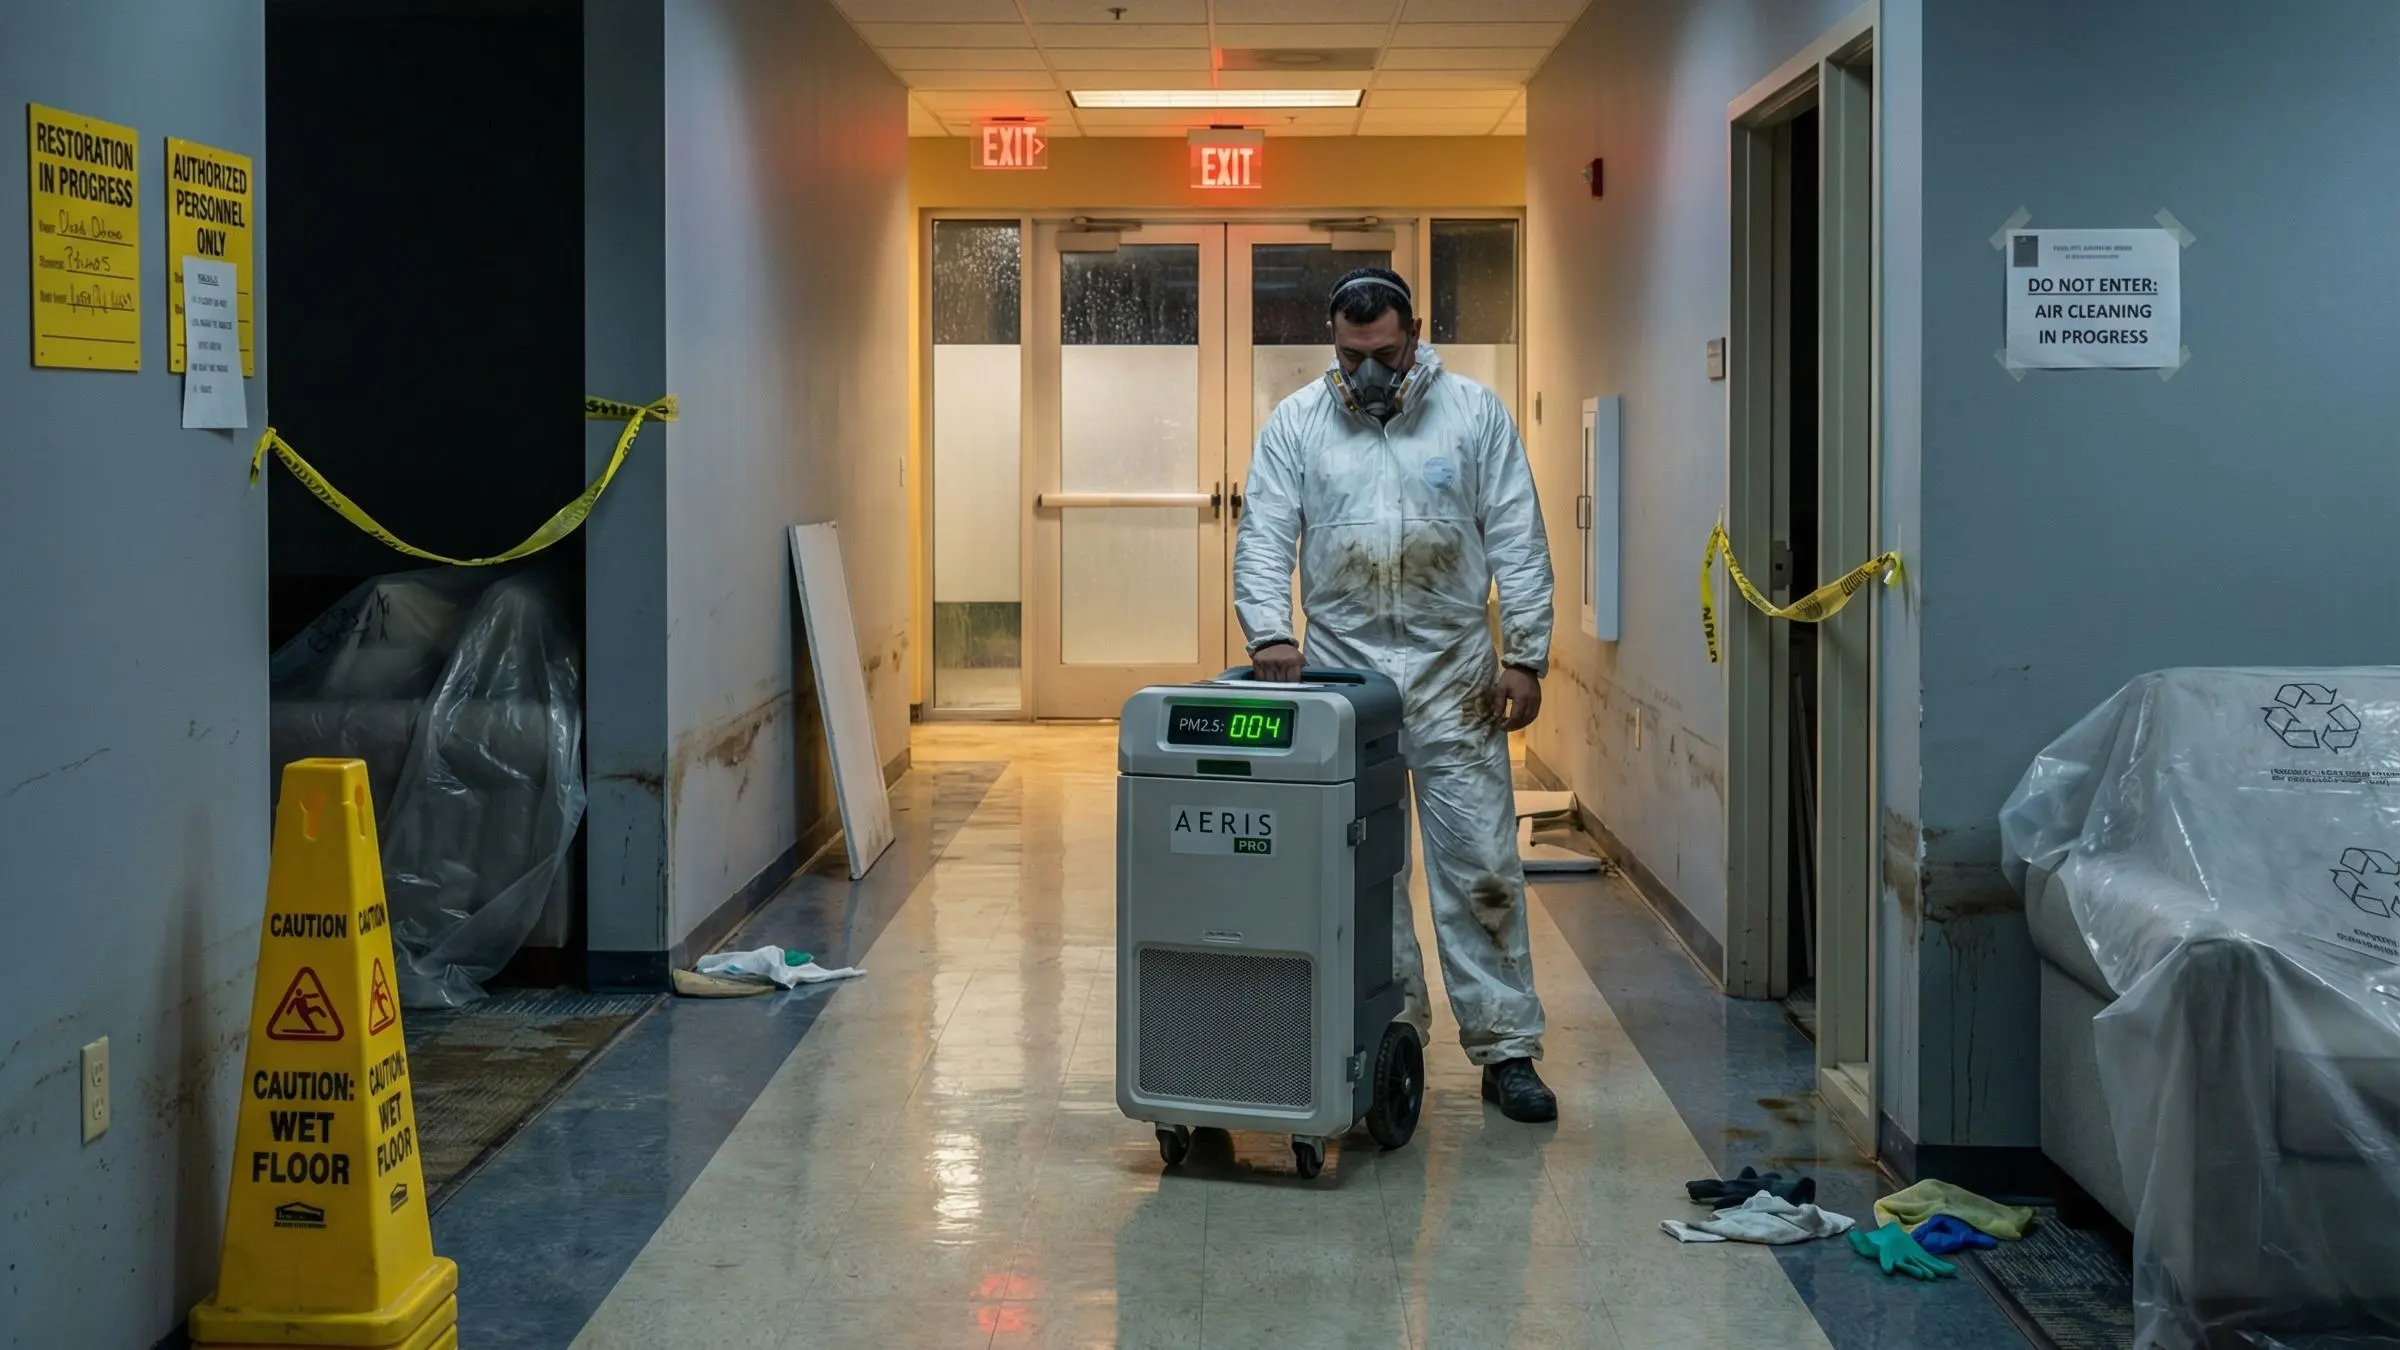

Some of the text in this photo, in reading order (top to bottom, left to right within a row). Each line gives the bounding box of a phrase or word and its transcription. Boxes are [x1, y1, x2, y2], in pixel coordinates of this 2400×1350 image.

[37, 121, 133, 172] RESTORATION
[982, 127, 1036, 166] EXIT
[174, 152, 247, 195] AUTHORIZED
[1201, 147, 1253, 186] EXIT
[39, 162, 133, 208] IN PROGRESS
[176, 190, 245, 228] PERSONNEL
[197, 227, 226, 257] ONLY
[2028, 278, 2158, 292] DO NOT ENTER:
[2035, 304, 2152, 319] AIR CLEANING
[2039, 330, 2148, 345] IN PROGRESS
[1230, 714, 1281, 739] 004
[1174, 810, 1272, 836] AERIS
[1238, 840, 1268, 852] PRO
[270, 913, 348, 939] CAUTION
[358, 902, 386, 935] CAUTION
[253, 1070, 355, 1101] CAUTION:
[270, 1111, 334, 1143] WET
[379, 1091, 402, 1133] WET
[377, 1126, 413, 1177] FLOOR
[252, 1152, 350, 1184] FLOOR
